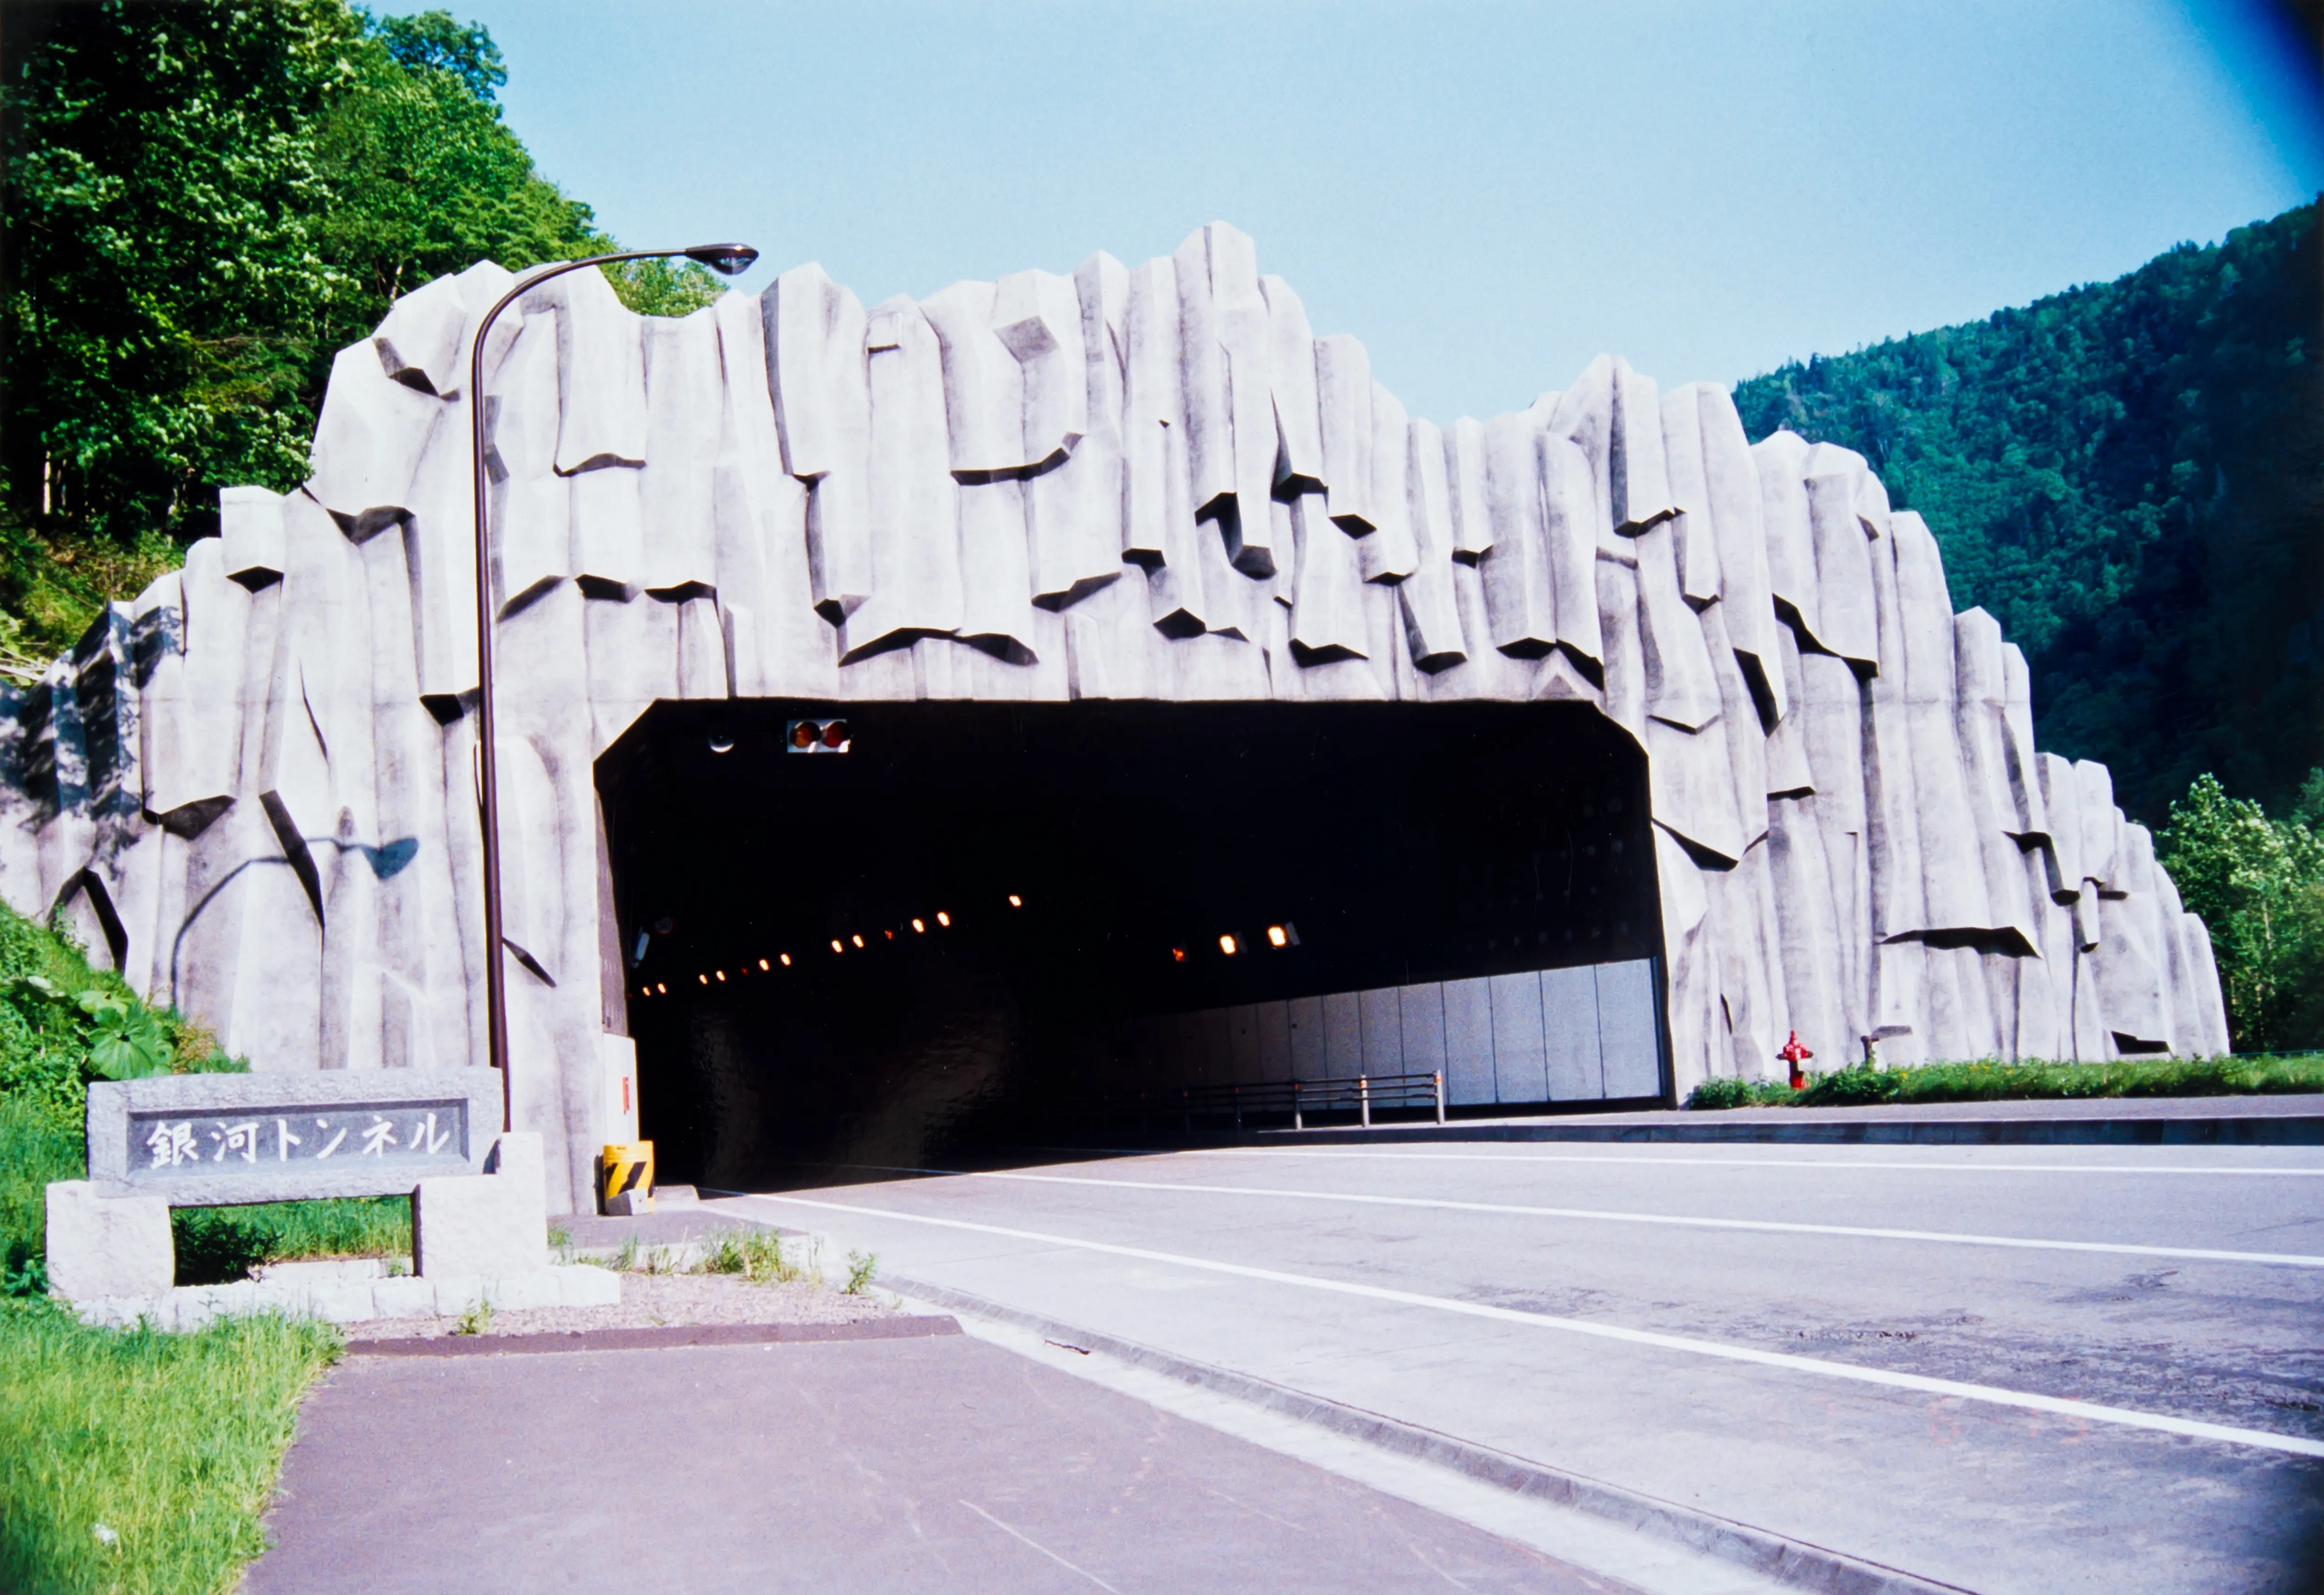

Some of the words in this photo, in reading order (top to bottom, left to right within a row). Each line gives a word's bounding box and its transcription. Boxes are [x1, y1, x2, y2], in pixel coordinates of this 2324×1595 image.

[146, 1113, 449, 1170] 銀河トンネル
